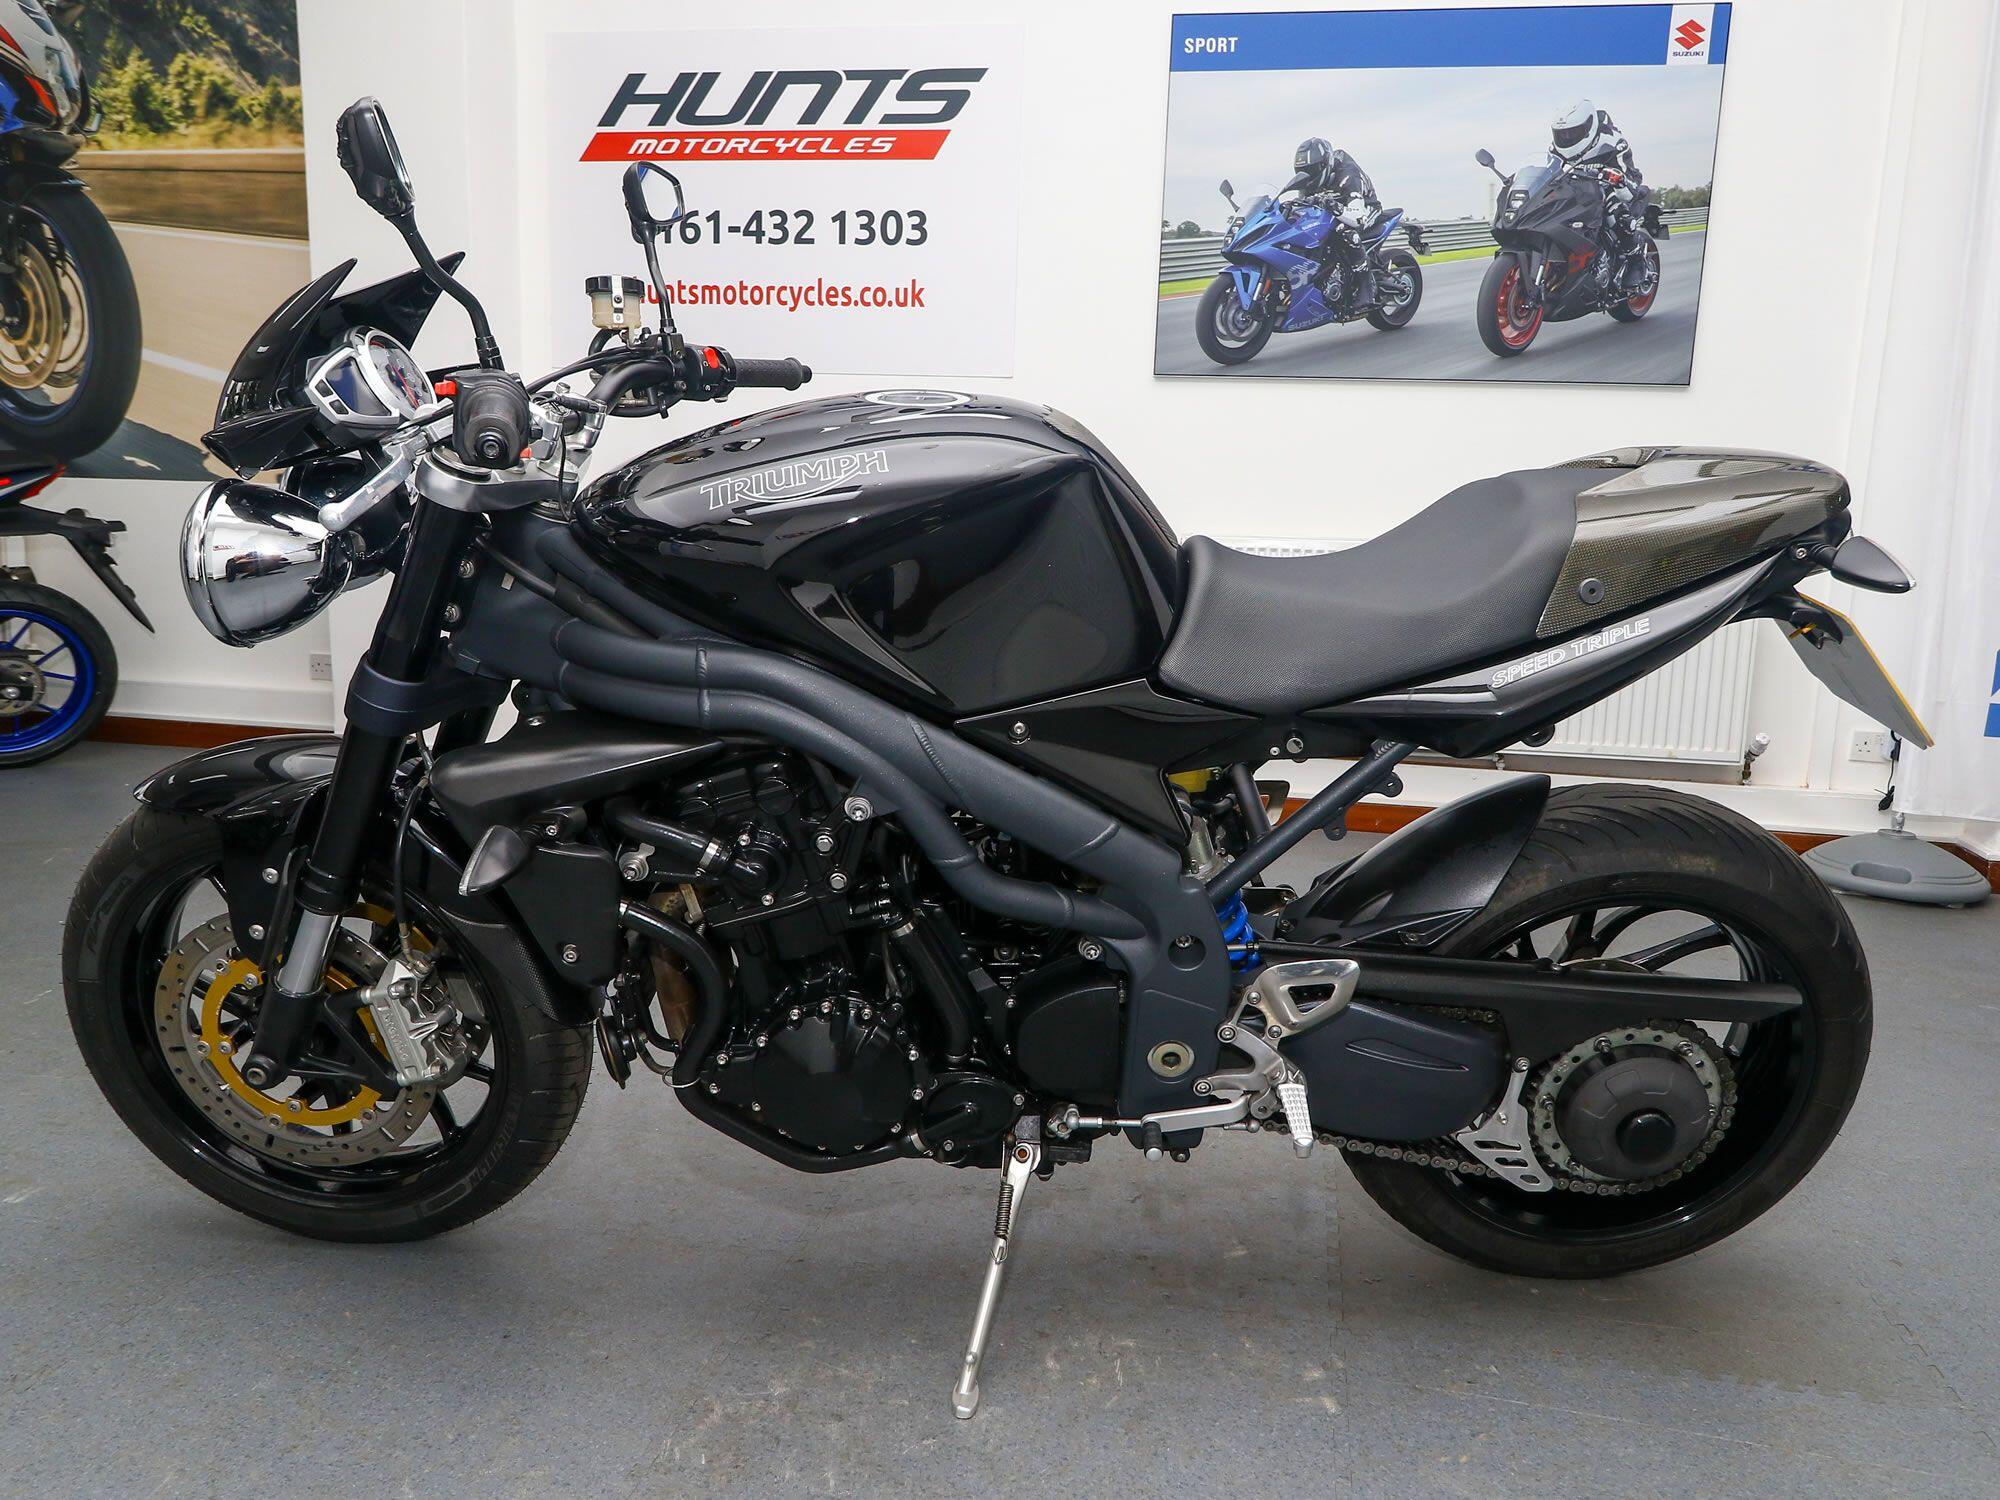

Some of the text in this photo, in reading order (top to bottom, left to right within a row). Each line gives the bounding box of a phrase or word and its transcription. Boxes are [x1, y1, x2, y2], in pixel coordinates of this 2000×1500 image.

[1184, 37, 1238, 54] SPORT
[597, 68, 989, 127] HUNTS
[628, 136, 897, 155] MOTORCYCLES
[831, 209, 928, 246] 1303
[640, 277, 924, 312] untsmotorcycles.co.uk
[700, 450, 890, 510] TRIUMPH
[1491, 618, 1650, 688] SPEED TRIPLE
